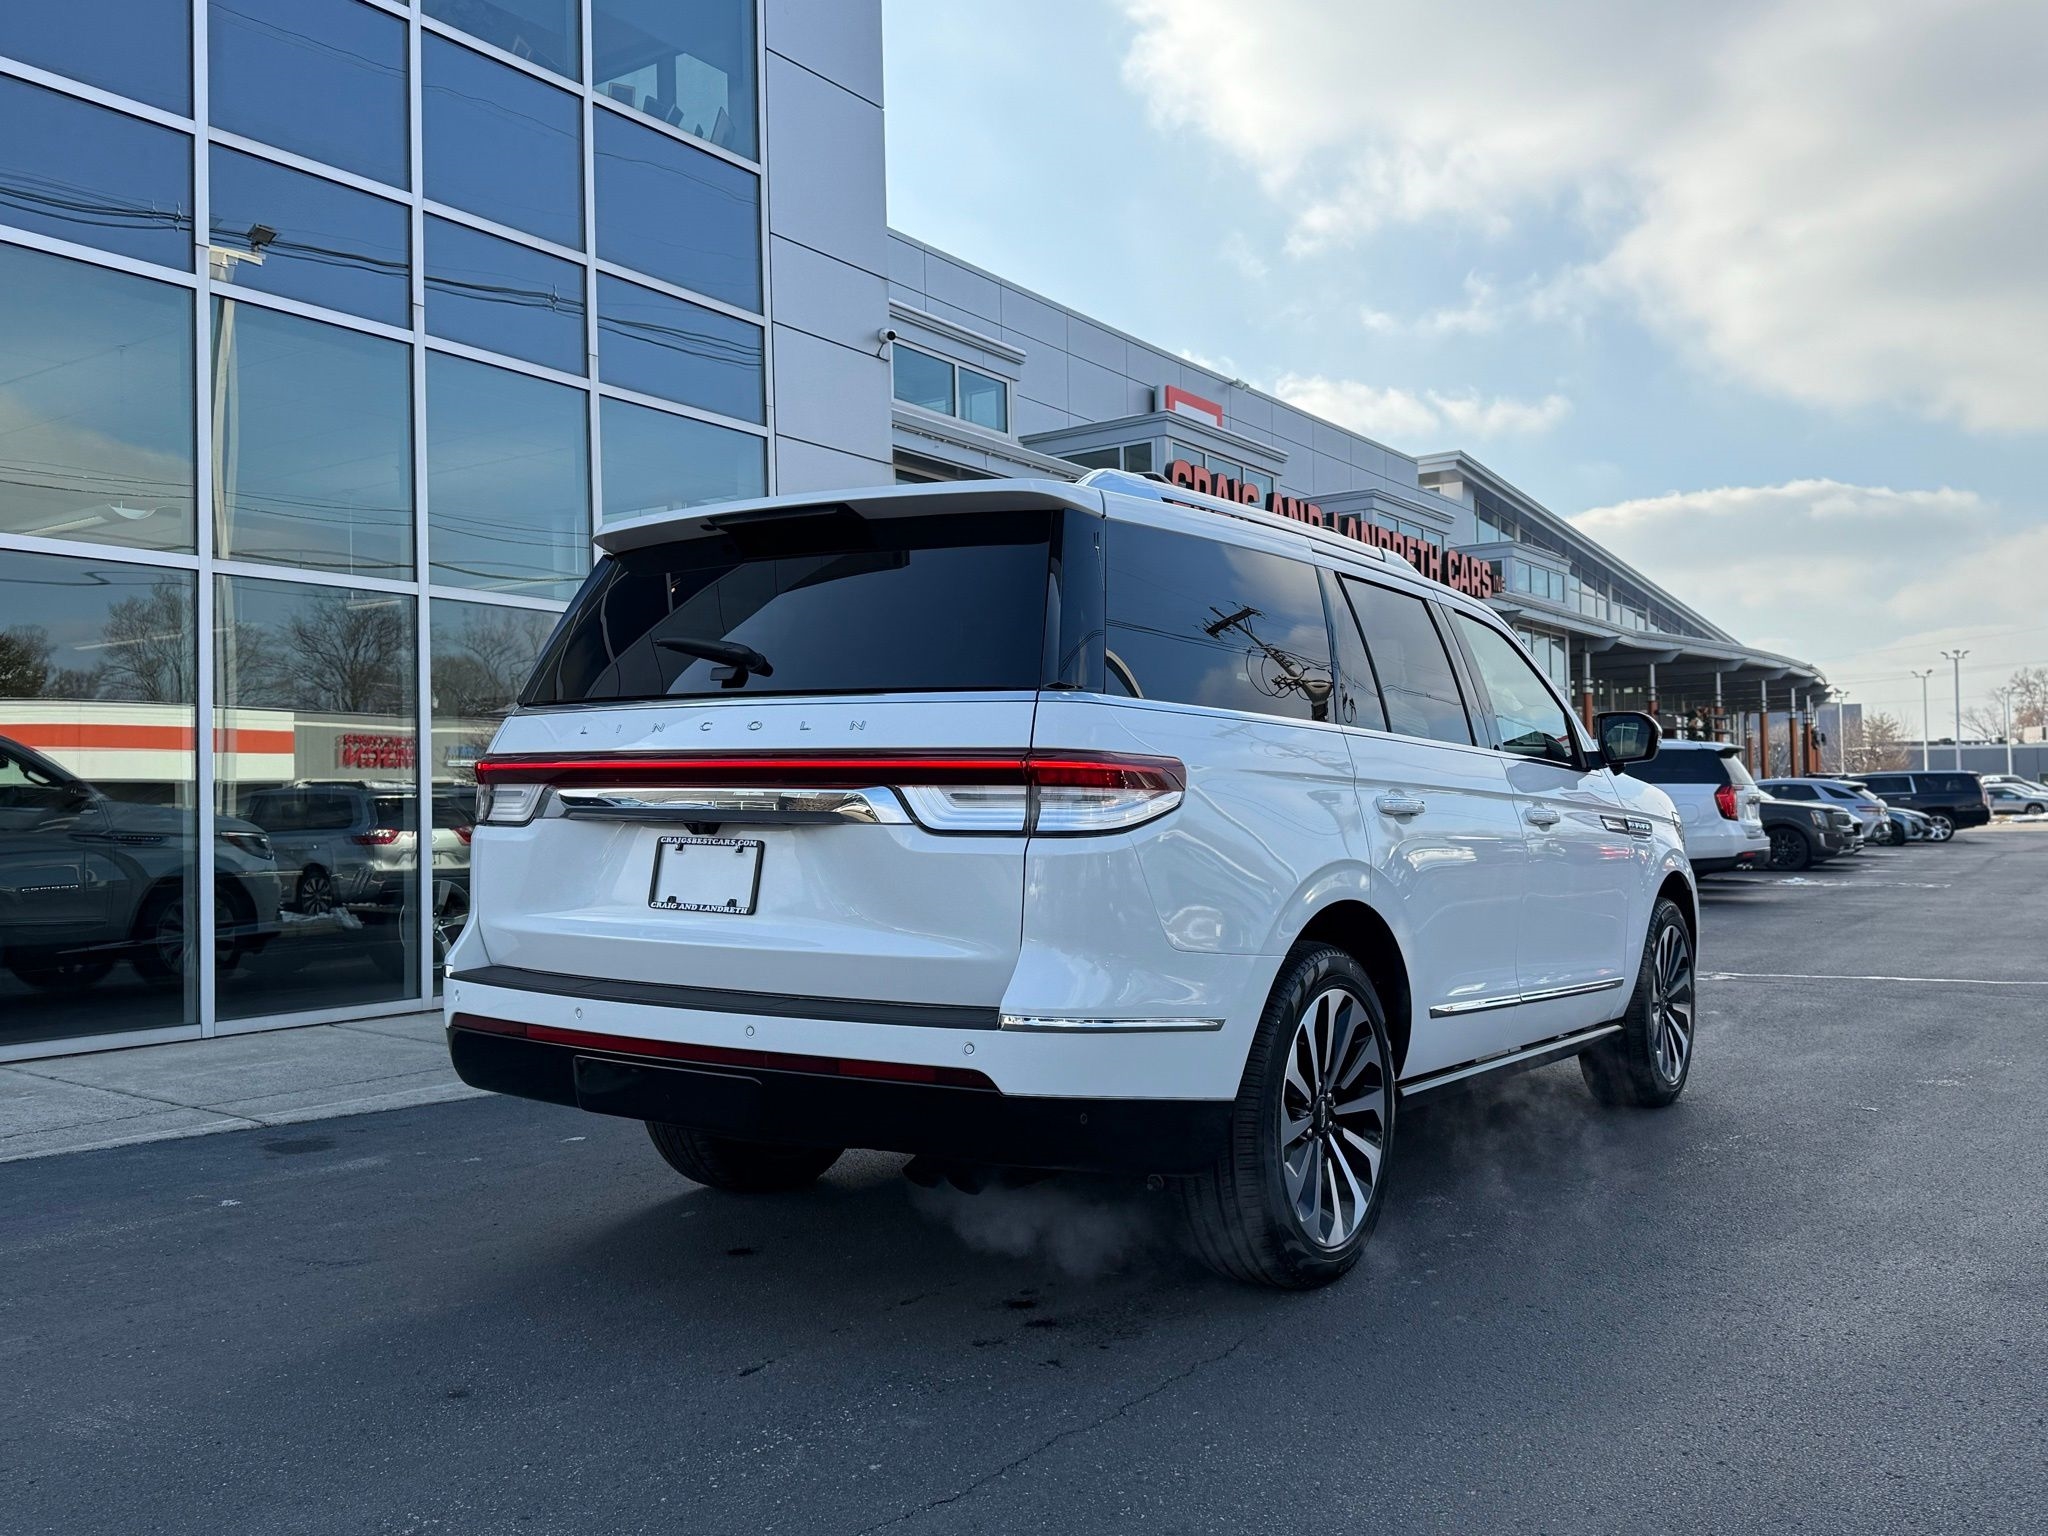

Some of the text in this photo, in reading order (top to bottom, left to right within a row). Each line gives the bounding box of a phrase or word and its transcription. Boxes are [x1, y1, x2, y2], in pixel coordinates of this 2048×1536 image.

[1446, 549, 1493, 599] CARS
[580, 720, 867, 735] LINCOLN
[660, 836, 758, 847] CRAIGSBESTCARS.COM
[650, 901, 677, 910] CRAIG
[699, 905, 748, 915] LANDRETH
